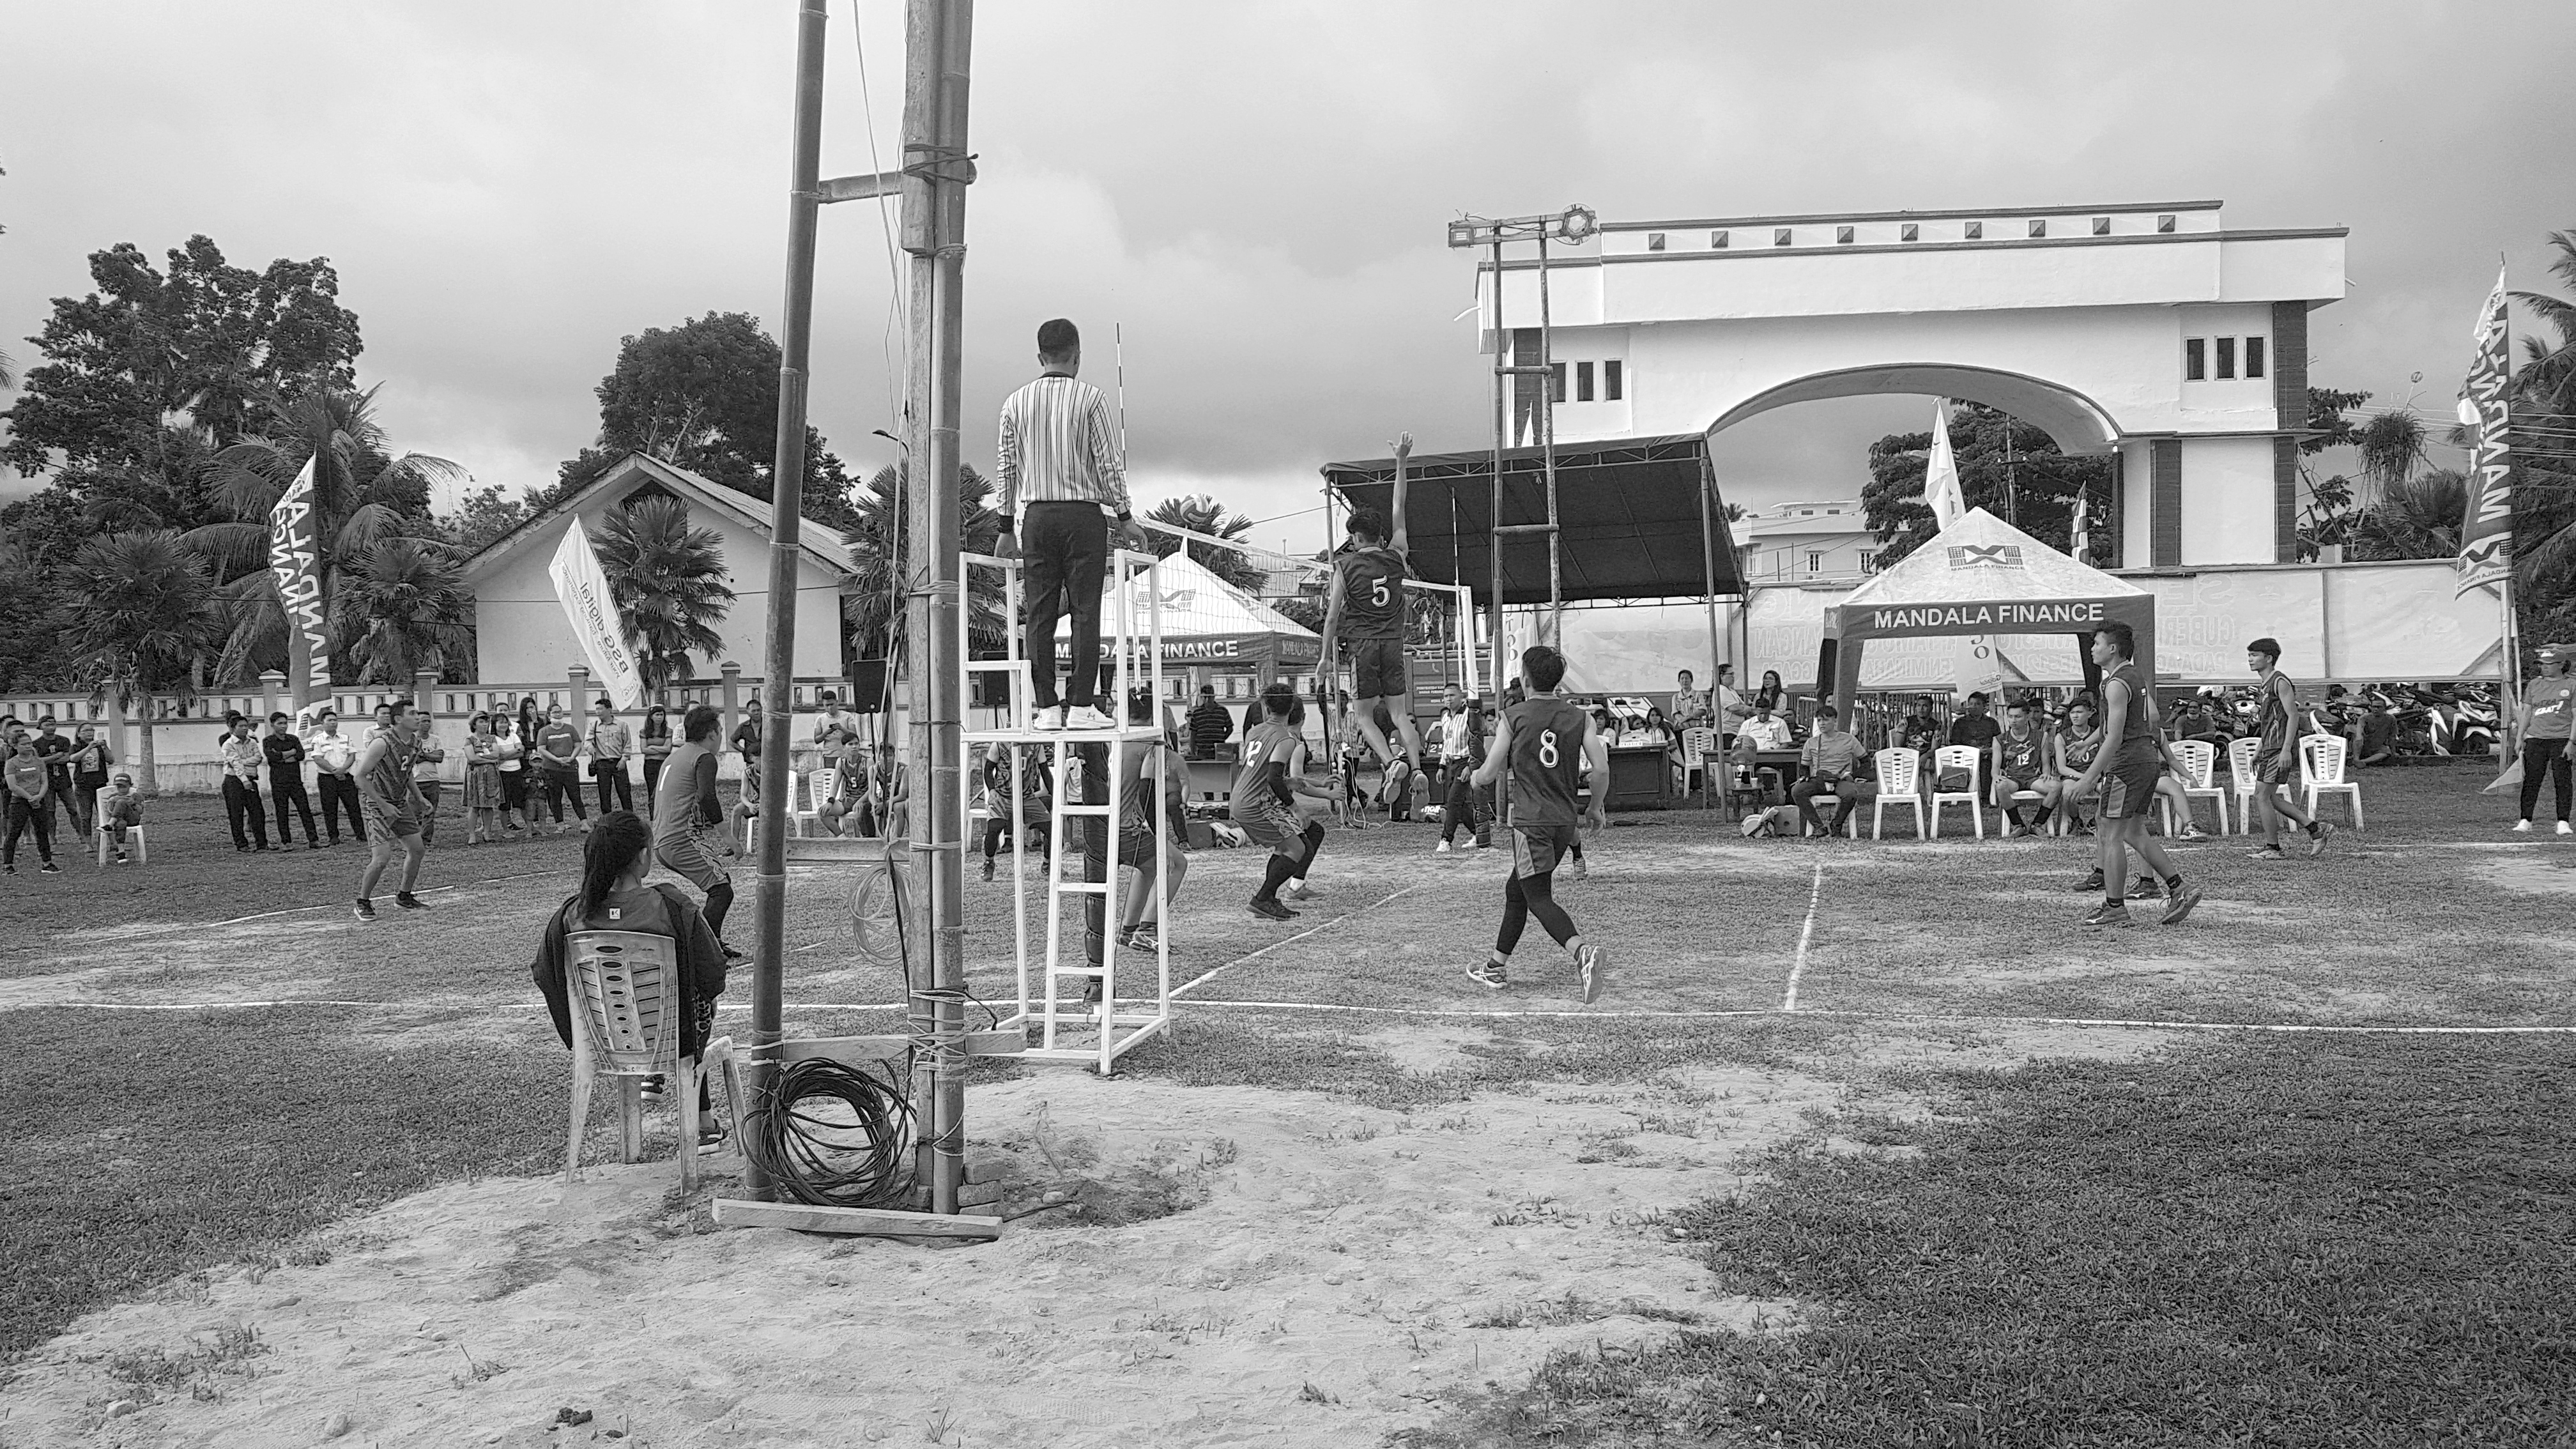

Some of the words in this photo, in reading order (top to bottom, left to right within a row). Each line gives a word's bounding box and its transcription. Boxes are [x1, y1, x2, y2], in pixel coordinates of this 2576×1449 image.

[1371, 574, 1391, 607] 5
[1874, 606, 1993, 629] MANDALA
[1998, 603, 2104, 624] FINANCE
[1539, 728, 1559, 768] 8
[2016, 753, 2030, 766] 12
[400, 756, 409, 771] 2
[659, 763, 672, 791] 1
[850, 777, 857, 788] 5
